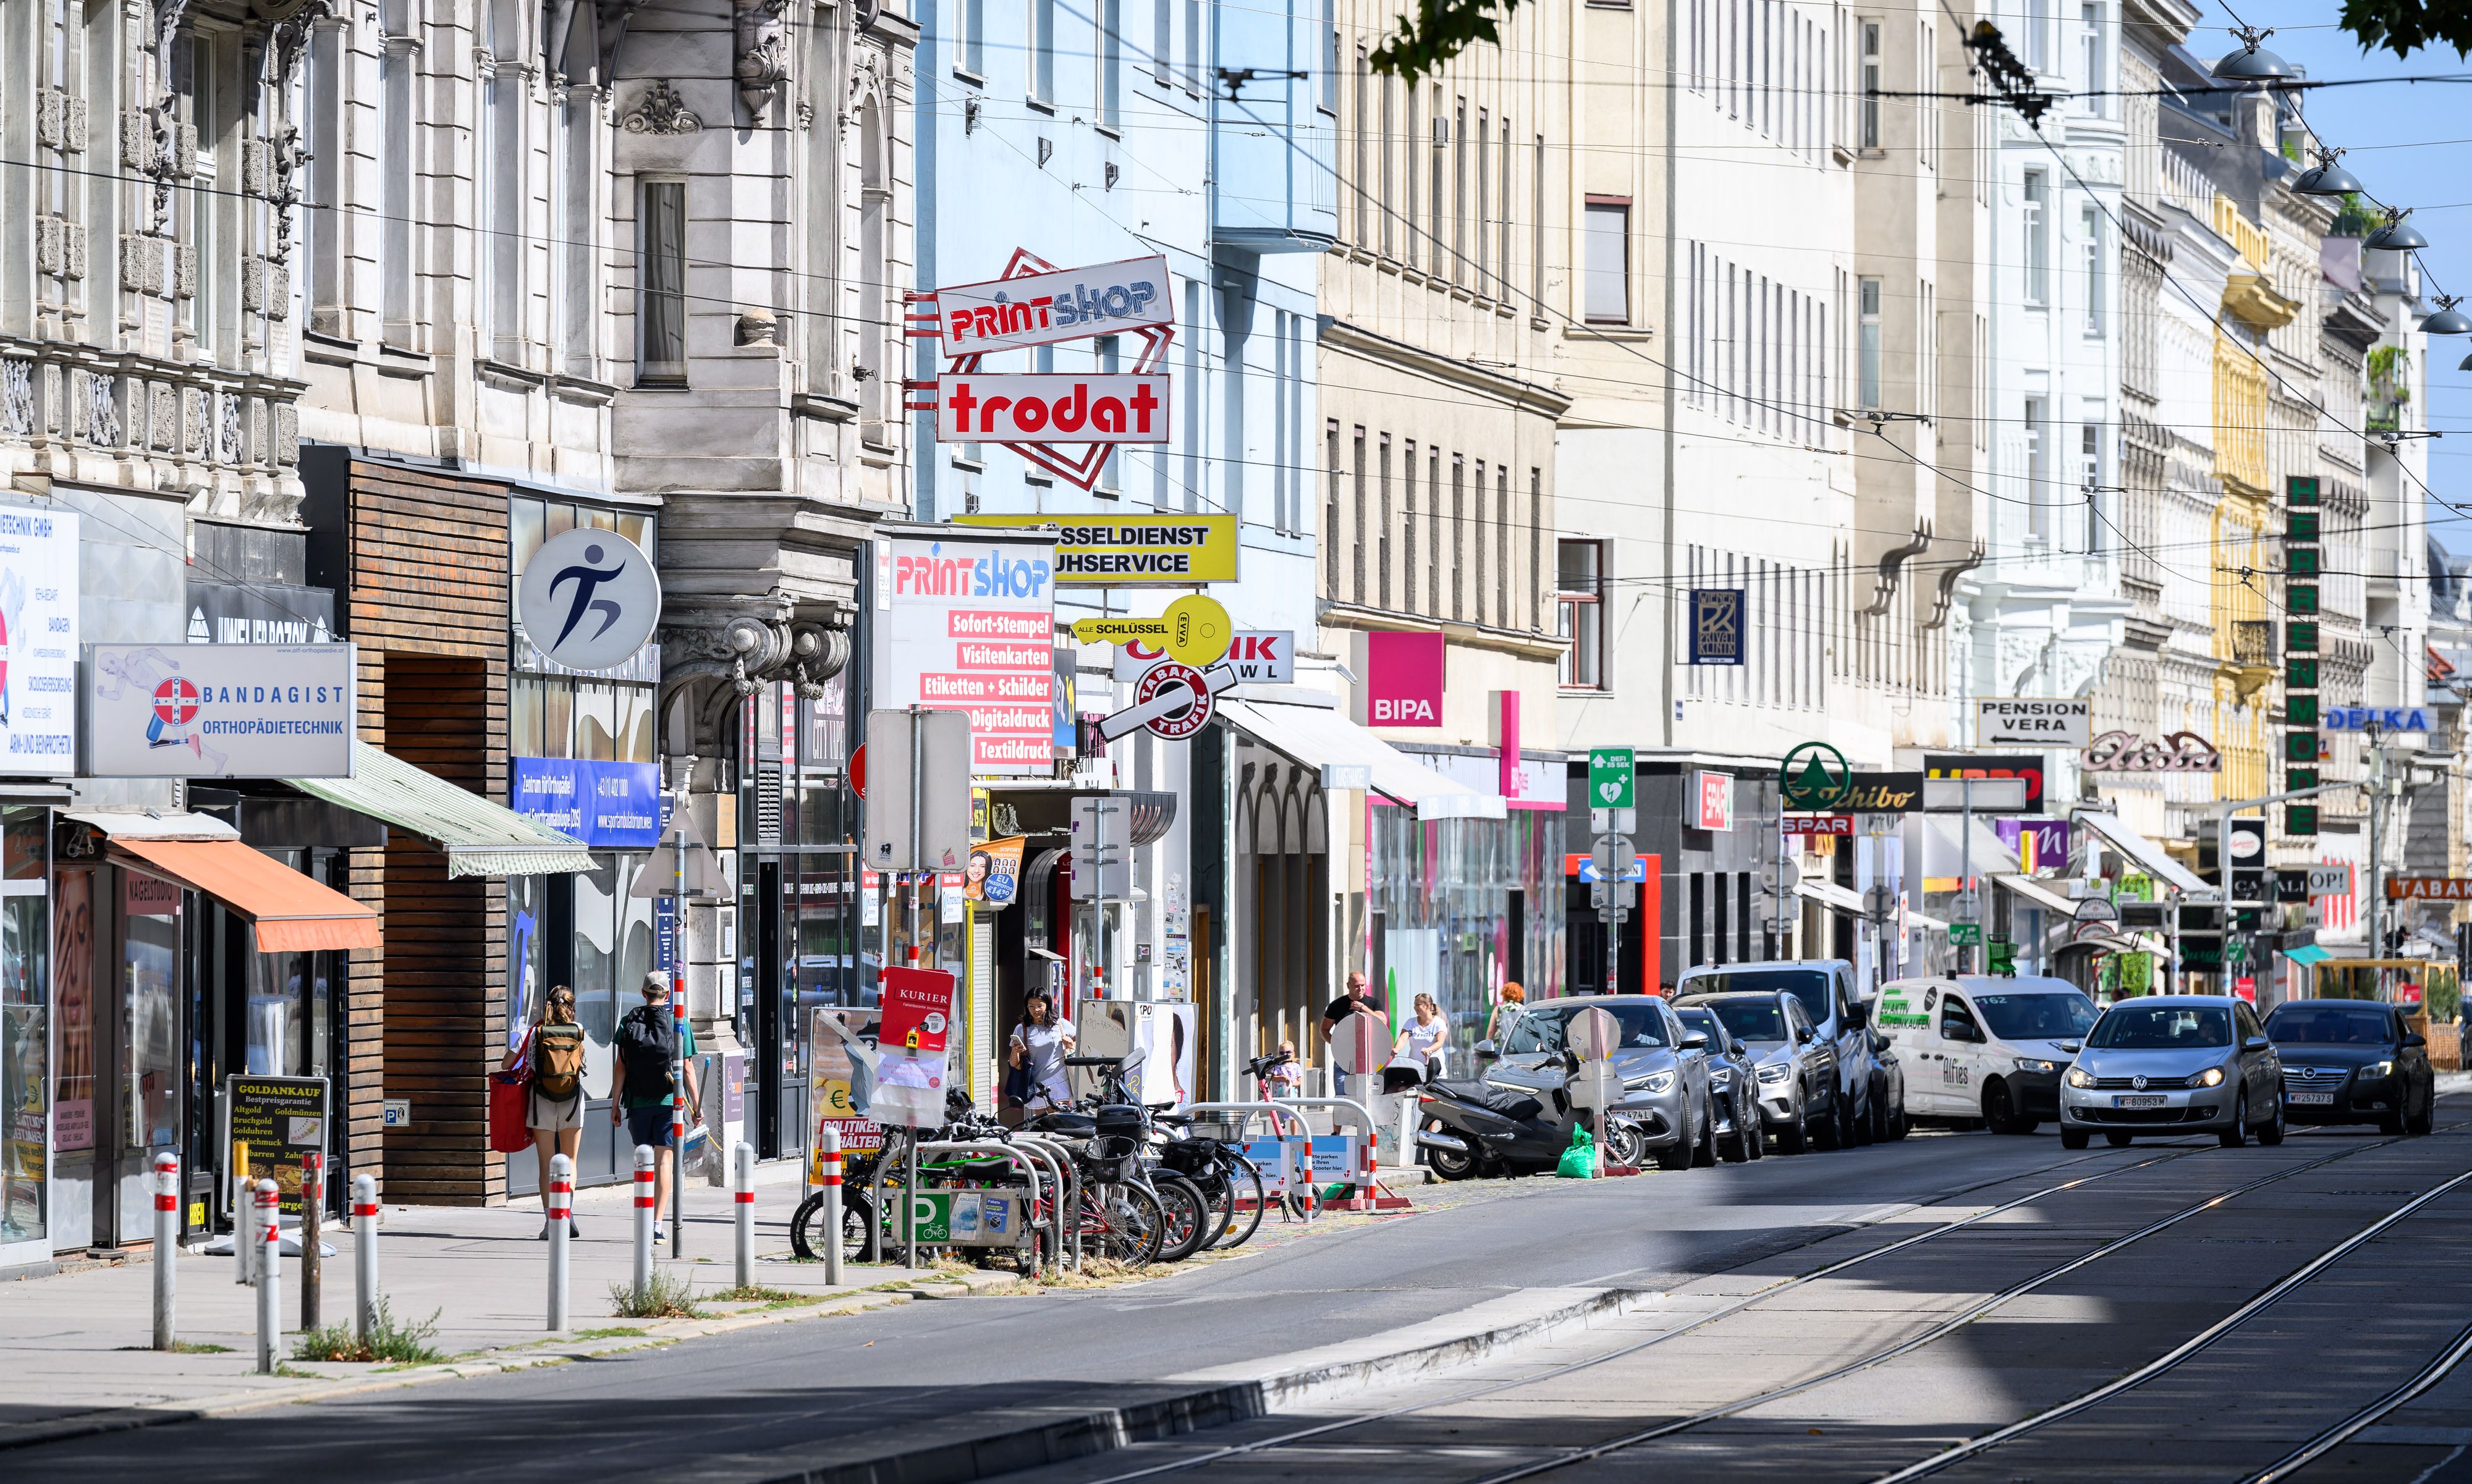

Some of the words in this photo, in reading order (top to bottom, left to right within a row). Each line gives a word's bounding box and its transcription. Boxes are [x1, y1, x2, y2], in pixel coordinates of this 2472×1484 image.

[949, 383, 1158, 433] trodat
[954, 615, 1049, 638] Sofort-Stempel
[1096, 622, 1168, 634] SCHLÜSSEL
[1179, 617, 1187, 643] EVVA
[963, 644, 1049, 665] Visitenkarten
[926, 677, 984, 695] Etiketten
[998, 678, 1049, 697] Schilder
[1141, 667, 1195, 699] TABAK
[203, 686, 343, 703] BANDAGIST
[1158, 693, 1208, 734] TRAFIK
[1375, 699, 1434, 720] BIPA
[1982, 703, 2086, 715] PENSION
[203, 718, 343, 735] ORTHOPÄDIETECHNIK
[971, 709, 1049, 731] Digitaldruck
[2002, 719, 2066, 731] VERA
[980, 740, 1051, 760] Textildruck
[523, 774, 541, 794] Zentrum
[548, 775, 570, 798] Orthopädie
[619, 779, 628, 797] 1000
[1706, 783, 1725, 819] SPAR
[1782, 818, 1847, 832] SPAR
[988, 879, 1013, 892] PASSFOTOS
[996, 875, 1009, 884] EU
[129, 880, 172, 901] NAGELSTUDIO
[900, 989, 947, 1004] KURIER
[1881, 1003, 1889, 1014] ZU
[1890, 1003, 1911, 1014] AKTIV
[1877, 1018, 1891, 1029] ZUM
[1892, 1018, 1931, 1030] EINKAUFEN
[1944, 1058, 1968, 1085] Alfies
[239, 1085, 321, 1097] GOLDANKAUF
[245, 1095, 312, 1106] Bestpreisgarantie
[234, 1105, 261, 1115] Altgold
[275, 1108, 322, 1117] Goldmünzen
[387, 1111, 395, 1121] P
[233, 1117, 273, 1126] Bruchgold
[233, 1127, 273, 1136] Golduhren
[840, 1133, 881, 1149] HÄLTER
[247, 1150, 275, 1158] barren
